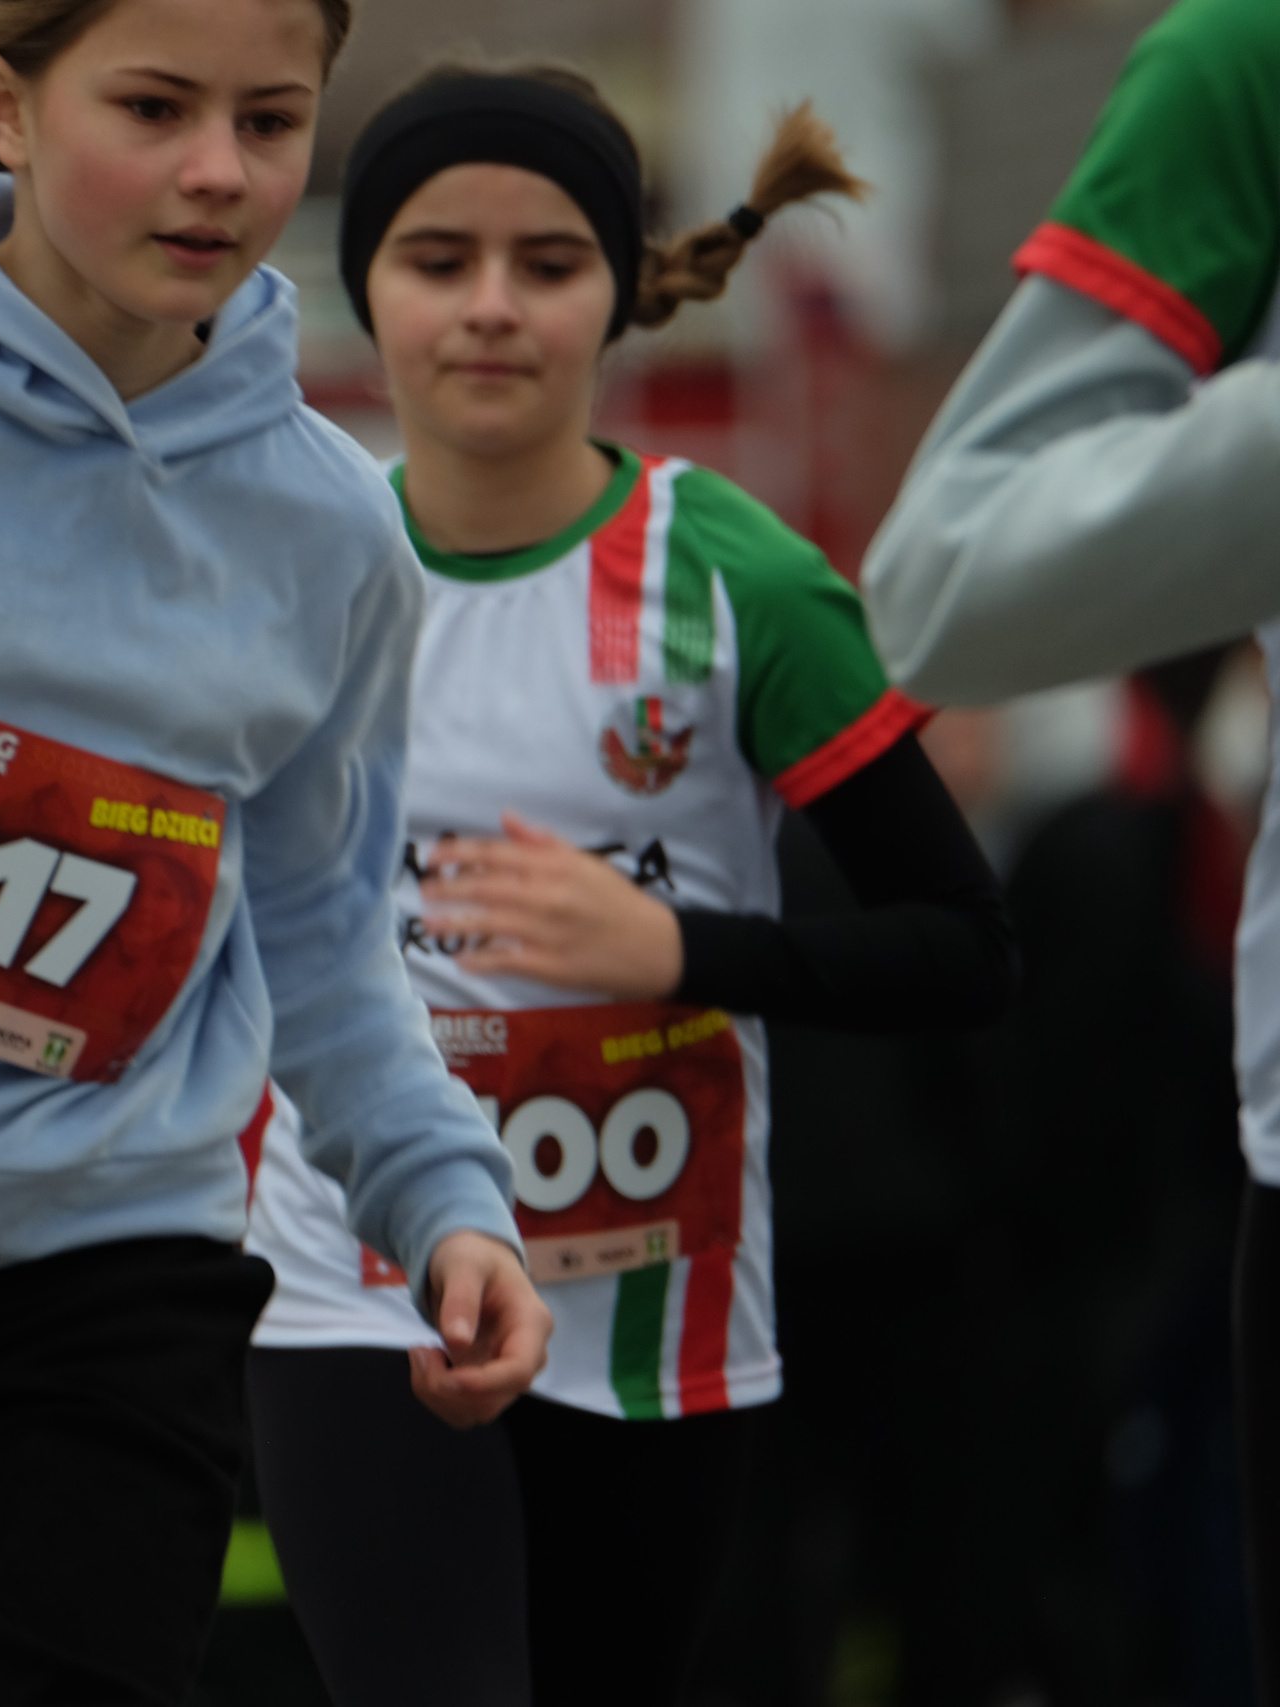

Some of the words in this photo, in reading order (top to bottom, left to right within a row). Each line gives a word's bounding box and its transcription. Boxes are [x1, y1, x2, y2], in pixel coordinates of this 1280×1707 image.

[89, 796, 150, 837] BIEG
[150, 807, 221, 849] DZIECI
[432, 1014, 508, 1041] BIEG
[475, 1086, 691, 1213] 00
